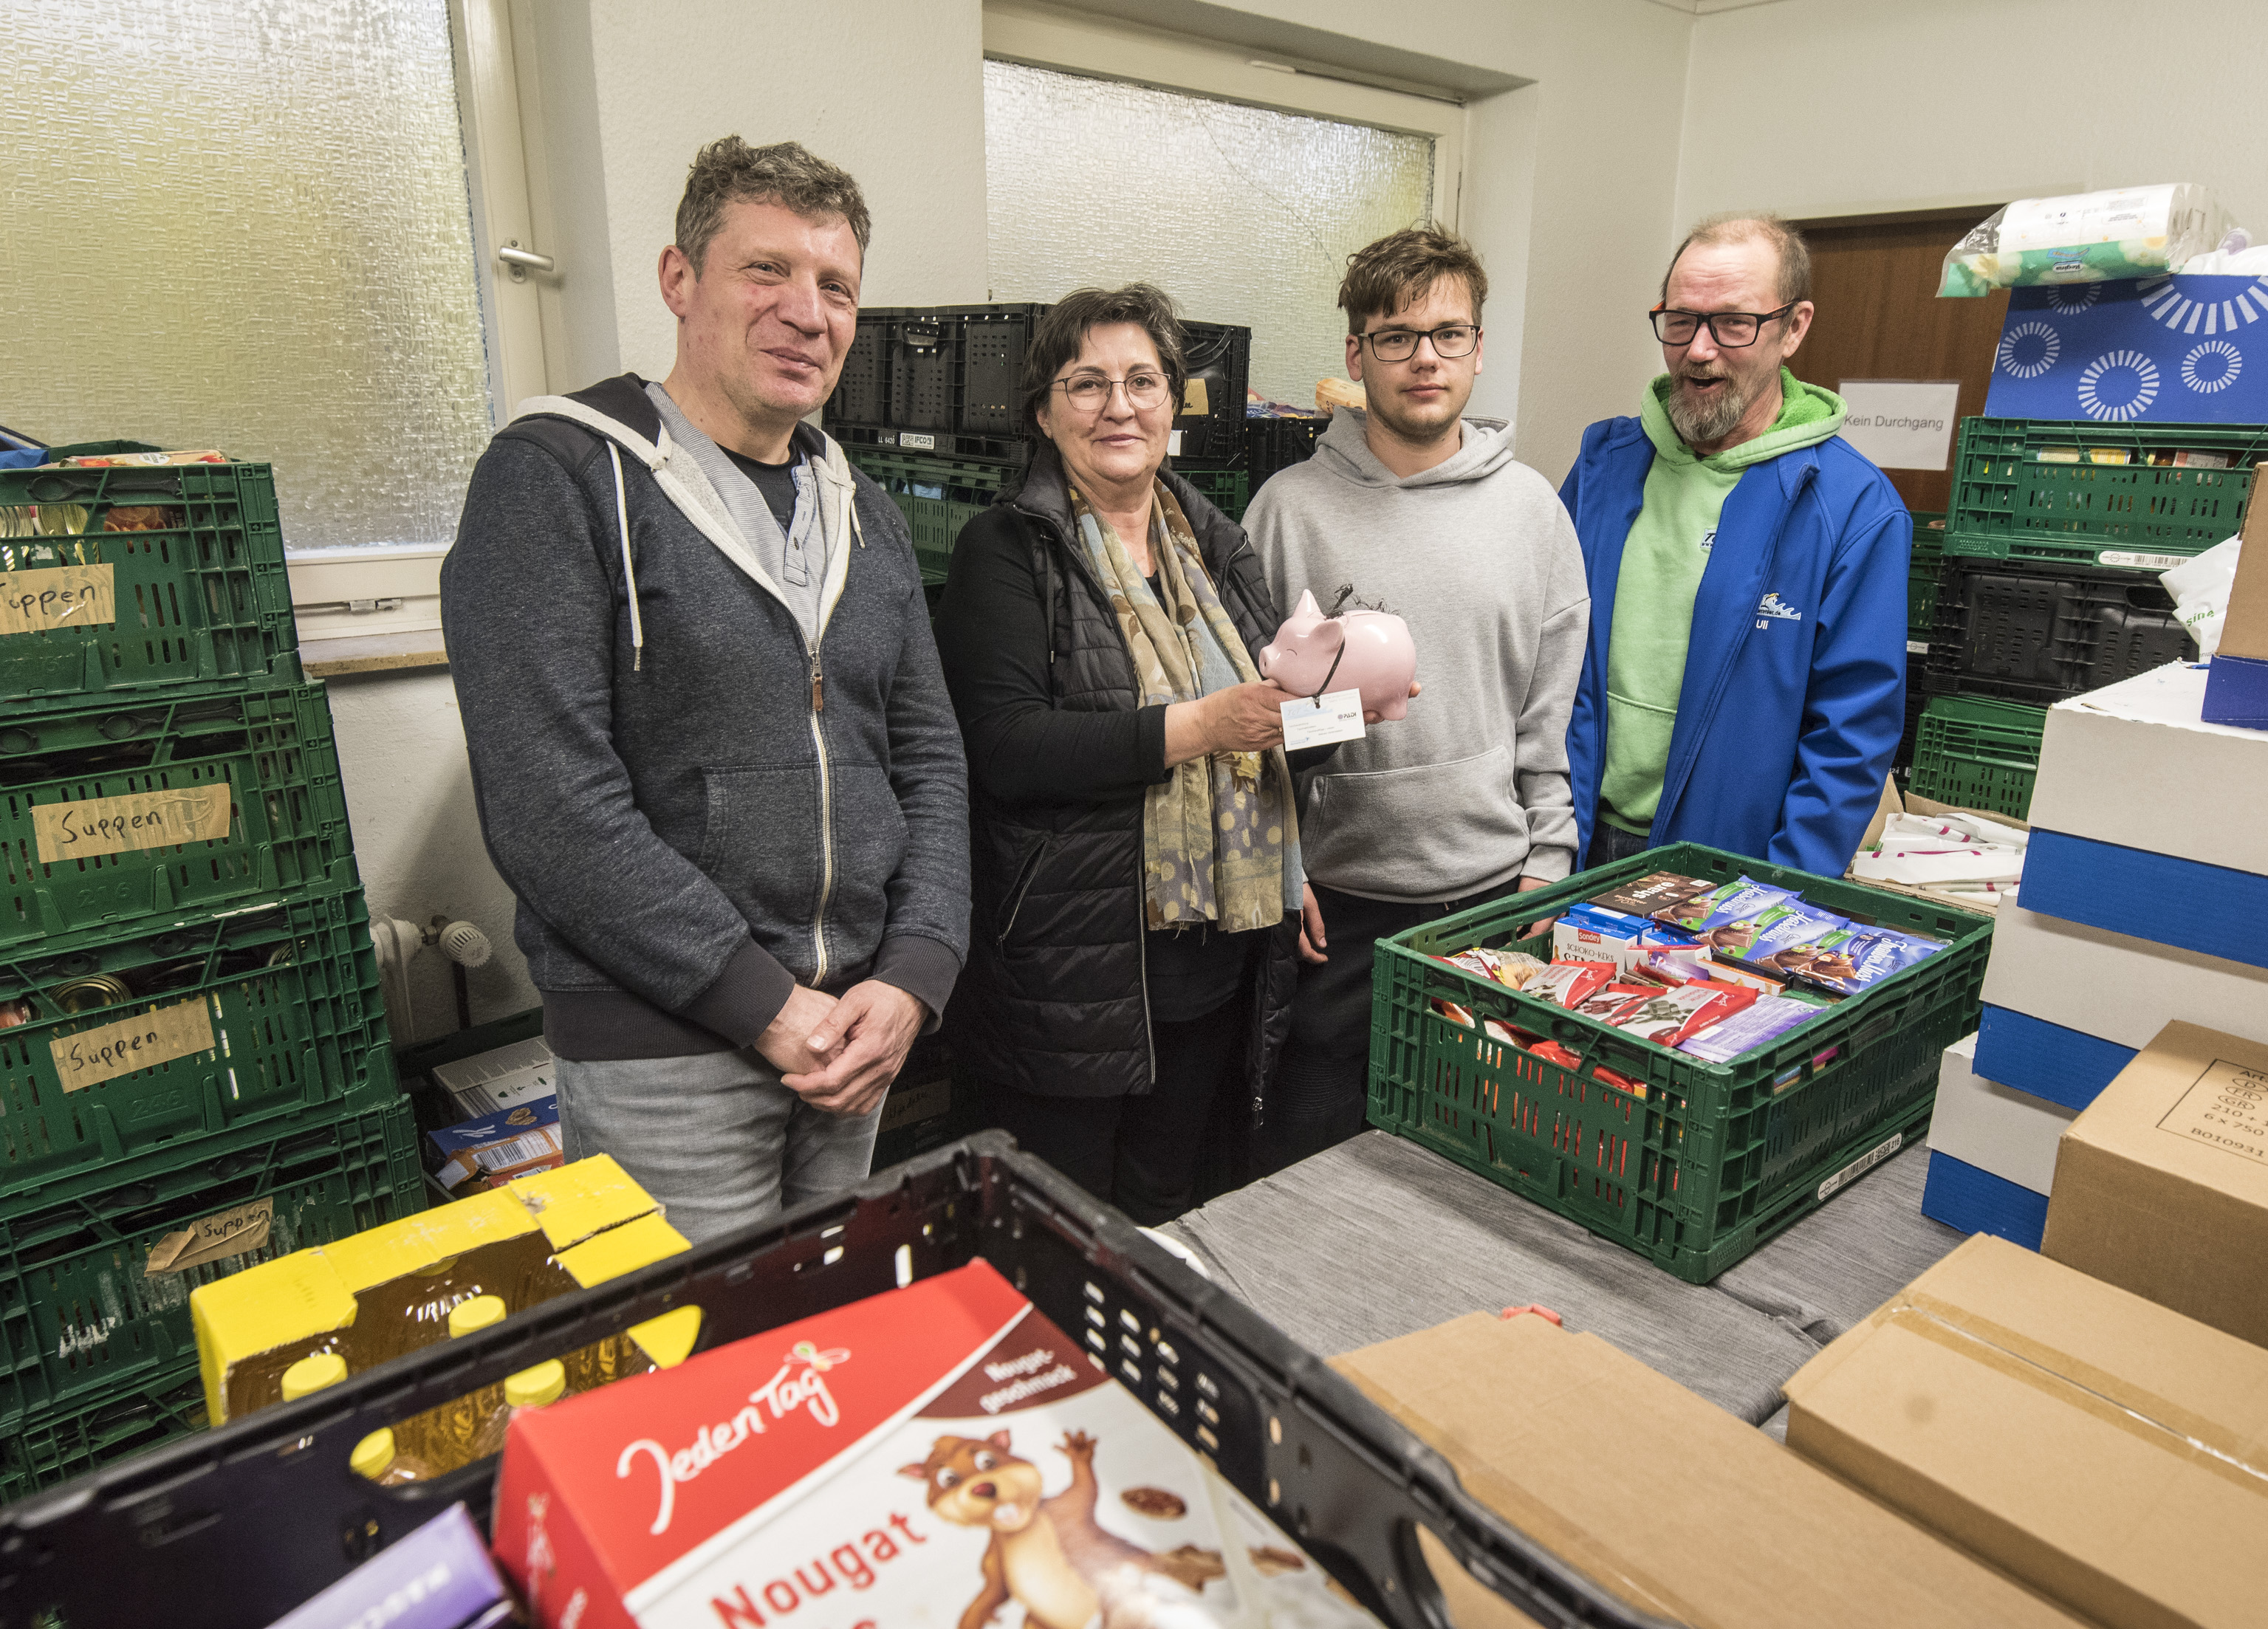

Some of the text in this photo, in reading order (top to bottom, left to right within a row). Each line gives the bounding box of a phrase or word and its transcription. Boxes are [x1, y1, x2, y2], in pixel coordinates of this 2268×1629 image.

[1844, 415, 1944, 431] Kein Durchgang
[914, 436, 927, 445] IFCO
[0, 583, 96, 618] uppen
[1755, 619, 1769, 630] Uli
[61, 809, 162, 843] Suppen
[1631, 881, 1675, 899] share
[1715, 884, 1768, 914] Haselnuss
[1578, 932, 1600, 943] Sondey
[1759, 909, 1814, 942] Haselnuss
[1566, 943, 1614, 962] SCHOKO-KEKS
[69, 1029, 158, 1072] Suppen
[2211, 1103, 2243, 1117] 210
[2190, 1128, 2264, 1157] B010931
[2233, 1122, 2264, 1136] 750
[203, 1209, 270, 1238] Suppen
[617, 1364, 840, 1535] Jeden Tag
[710, 1511, 928, 1629] Nougat
